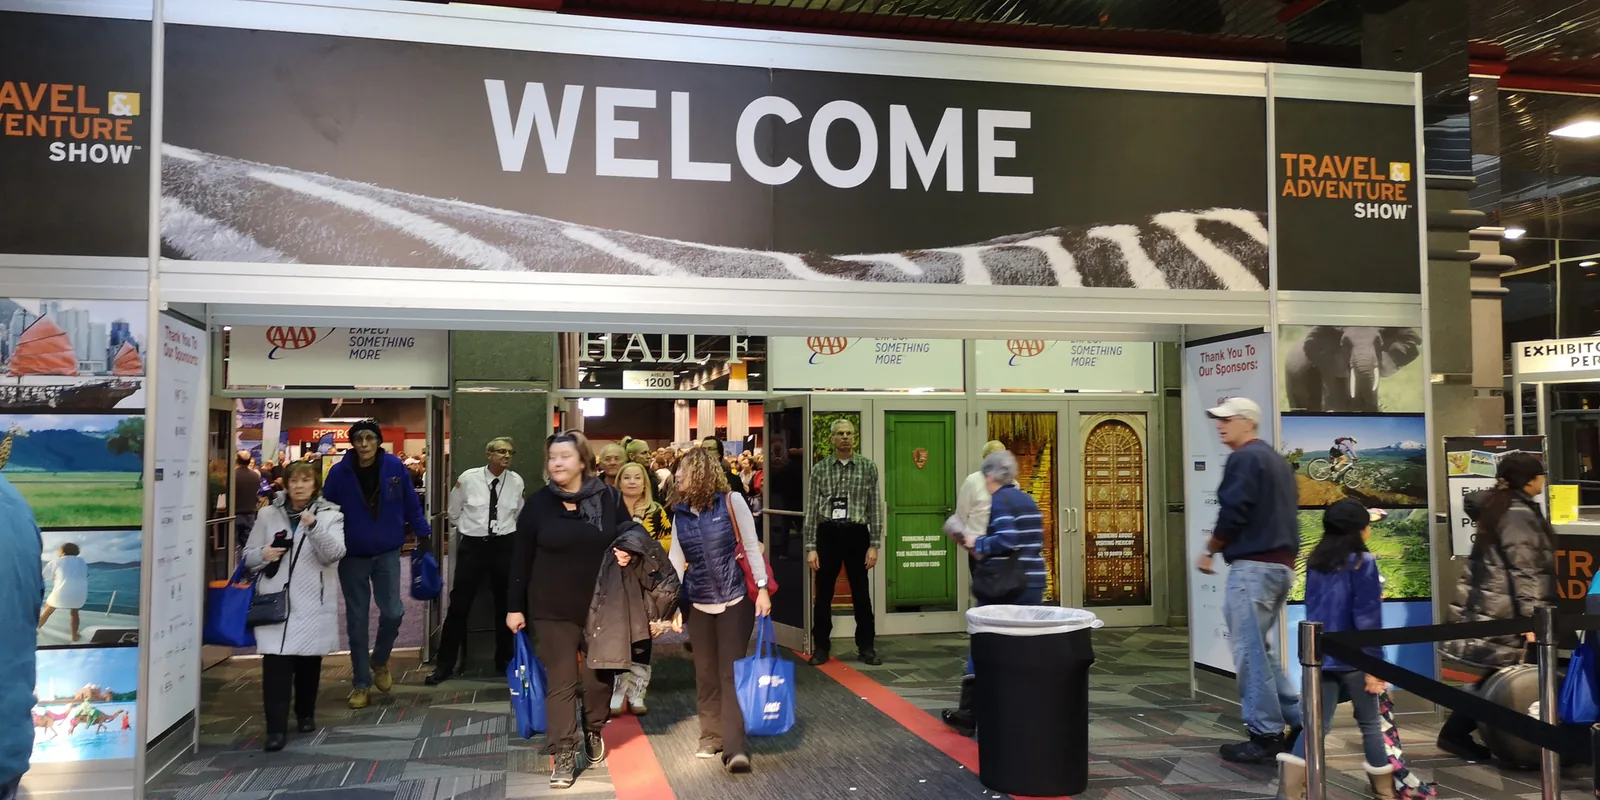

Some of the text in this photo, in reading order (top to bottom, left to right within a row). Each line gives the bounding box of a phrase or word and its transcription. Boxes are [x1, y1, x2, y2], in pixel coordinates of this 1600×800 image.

[484, 78, 1034, 194] WELCOME
[1280, 153, 1386, 180] TRAVEL
[1281, 179, 1407, 201] ADVENTURE
[270, 326, 311, 349] AAA
[349, 336, 415, 347] SOMETHING
[810, 336, 846, 354] AAA
[349, 349, 382, 360] MORE
[580, 333, 711, 363] HALL
[875, 343, 930, 353] SOMETHING
[1009, 340, 1043, 356] AAA
[1071, 346, 1123, 356] SOMETHING
[1200, 344, 1256, 363] Thank You To
[875, 354, 902, 364] MORE
[1071, 357, 1096, 367] MORE
[1199, 360, 1258, 377] Our Sponsors:
[644, 378, 671, 387] 1200
